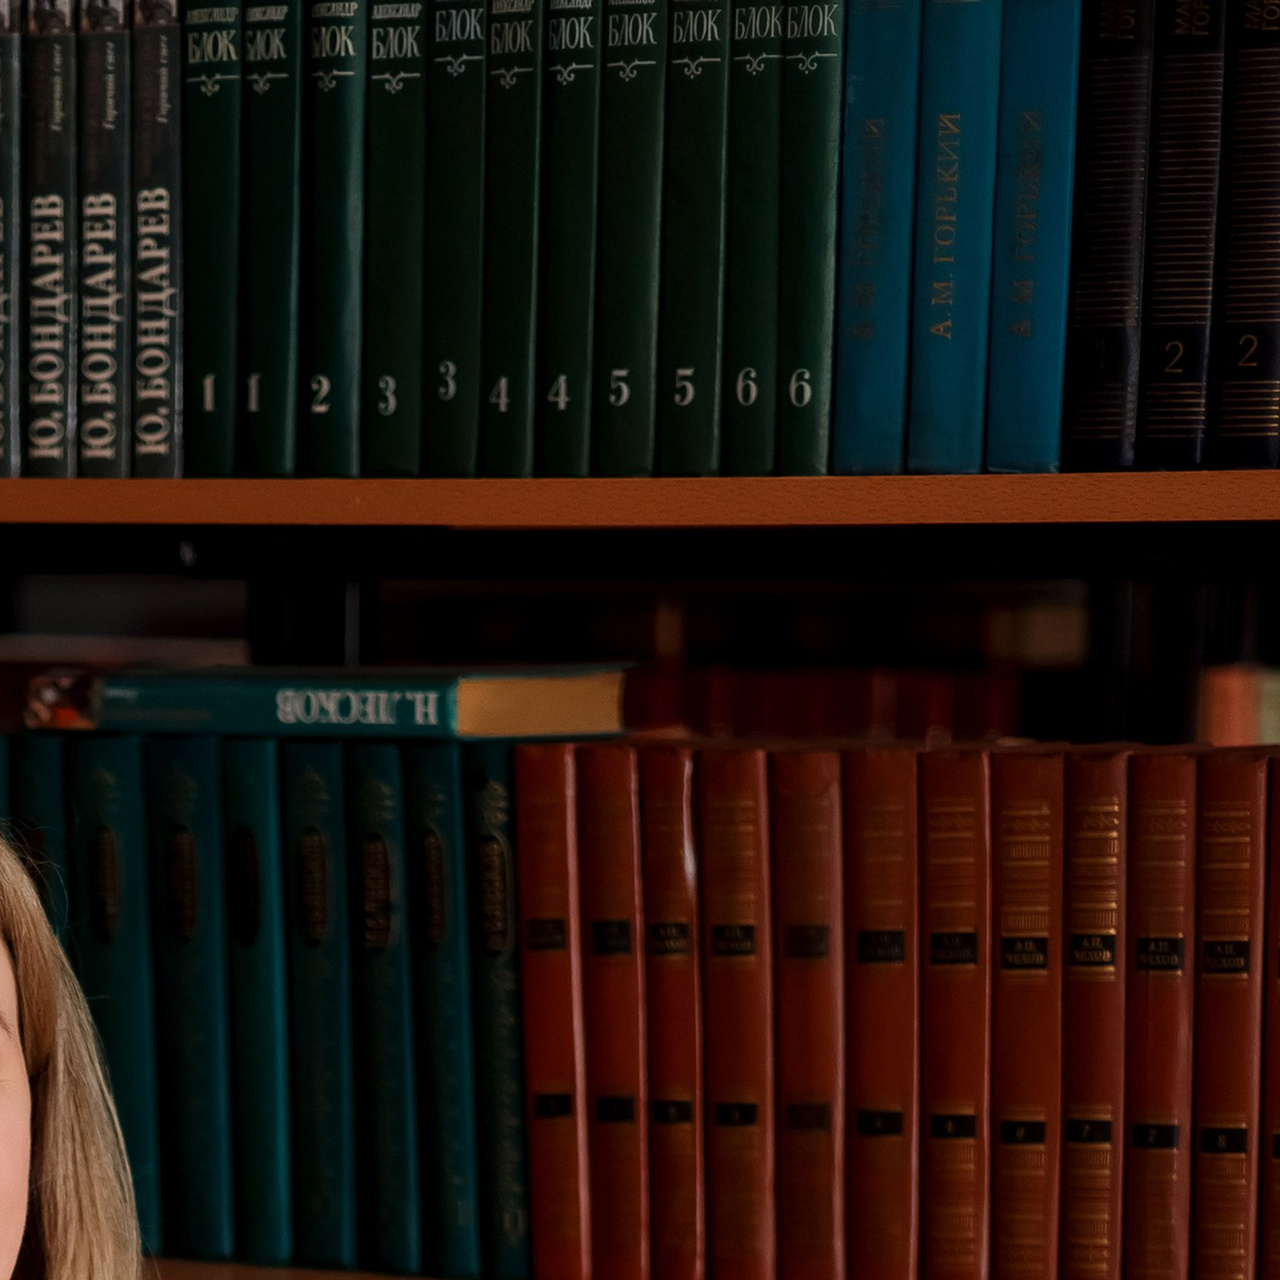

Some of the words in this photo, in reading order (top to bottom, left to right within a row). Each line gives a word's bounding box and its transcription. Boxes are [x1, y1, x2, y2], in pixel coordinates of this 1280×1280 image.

[434, 8, 485, 43] БЛОК
[489, 19, 534, 54] БЛОК
[548, 16, 595, 51] БЛОК
[607, 12, 658, 47] БЛОК
[672, 9, 723, 44] БЛОК
[734, 6, 786, 40] БЛОК
[786, 4, 839, 39] БЛОК
[186, 29, 239, 65] БЛОК
[245, 27, 289, 61] БЛОК
[311, 25, 357, 58] БЛОК
[371, 25, 422, 59] БЛОК
[28, 194, 73, 404] БОНДАРЕВ
[81, 193, 124, 404] БОНДАРЕВ
[135, 187, 177, 400] БОНДАРЕВ
[1163, 340, 1185, 374] 2
[1237, 333, 1259, 368] 2
[202, 371, 217, 413] 1
[246, 371, 262, 413] 1
[310, 373, 332, 414] 2
[377, 374, 398, 416] 3
[437, 360, 458, 401] 3
[488, 375, 512, 414] 4
[546, 373, 571, 412] 4
[608, 367, 631, 407] 5
[673, 367, 696, 407] 5
[735, 366, 759, 407] 6
[788, 367, 813, 408] 6
[28, 410, 64, 460] Ю.
[81, 410, 117, 460] Ю.
[135, 406, 170, 456] Ю.
[275, 687, 399, 726] ЛЕСКОВ
